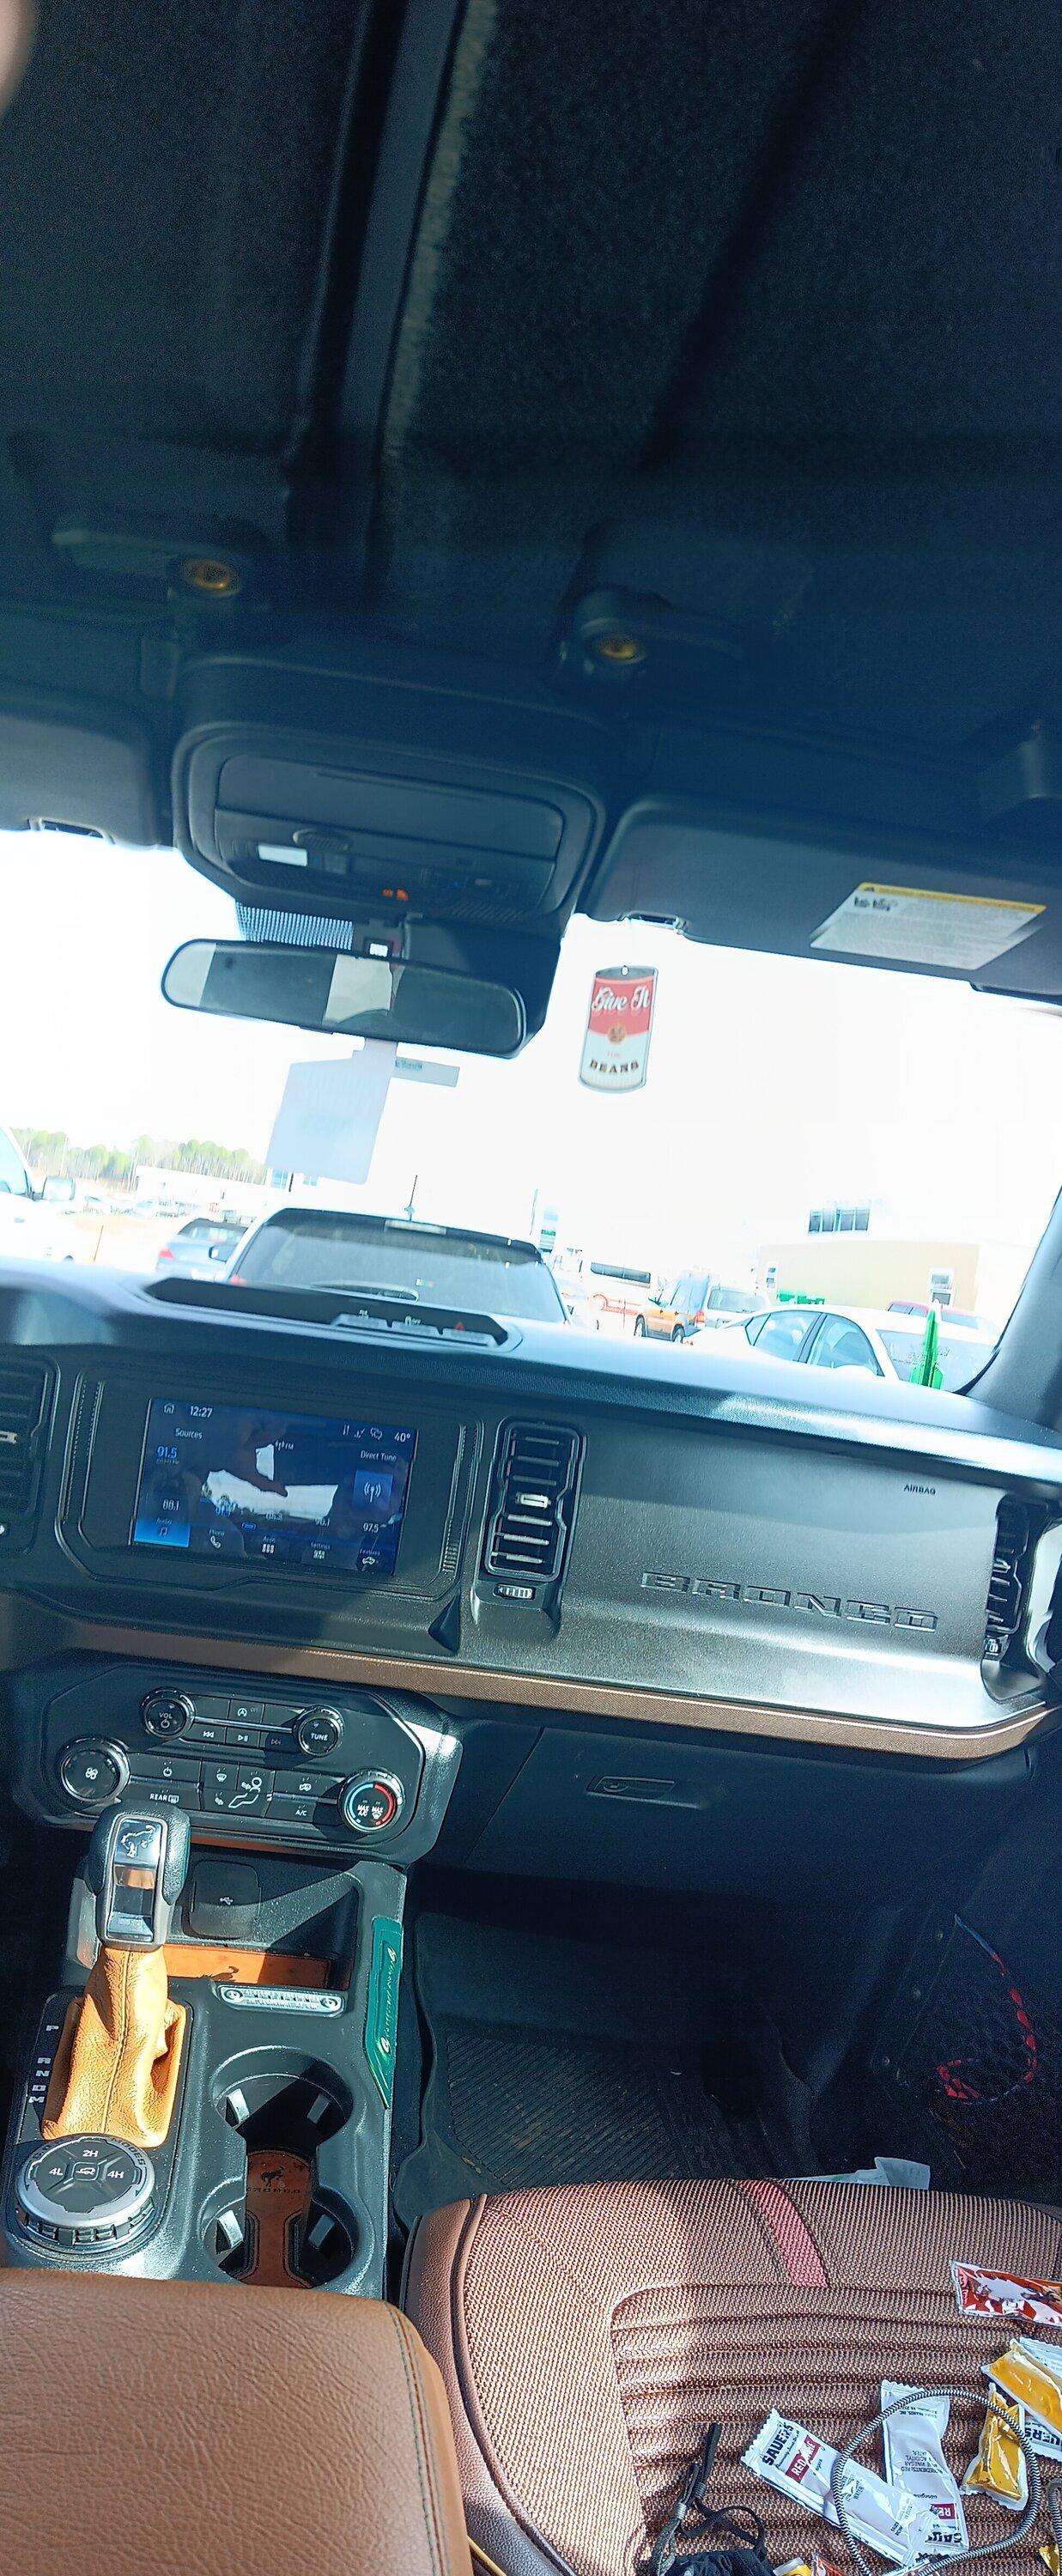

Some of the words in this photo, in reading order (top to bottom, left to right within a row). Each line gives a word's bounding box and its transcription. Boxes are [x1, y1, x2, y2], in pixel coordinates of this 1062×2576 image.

[592, 987, 628, 1012] Give
[630, 986, 651, 1011] It
[589, 1059, 640, 1074] BEANS
[190, 1406, 213, 1419] 12:27
[174, 1427, 203, 1440] Sources
[360, 1449, 379, 1461] Direct
[381, 1453, 397, 1461] Tune
[903, 1484, 937, 1495] AIRBAG
[640, 1571, 938, 1632] BRONCO
[310, 1733, 328, 1741] TUNE
[149, 1793, 167, 1801] REAR
[28, 2095, 45, 2104] M
[82, 2149, 99, 2158] 2H
[112, 2136, 146, 2169] MODES
[49, 2167, 64, 2176] 4L
[107, 2171, 124, 2179] 4H
[791, 2458, 807, 2476] RED
